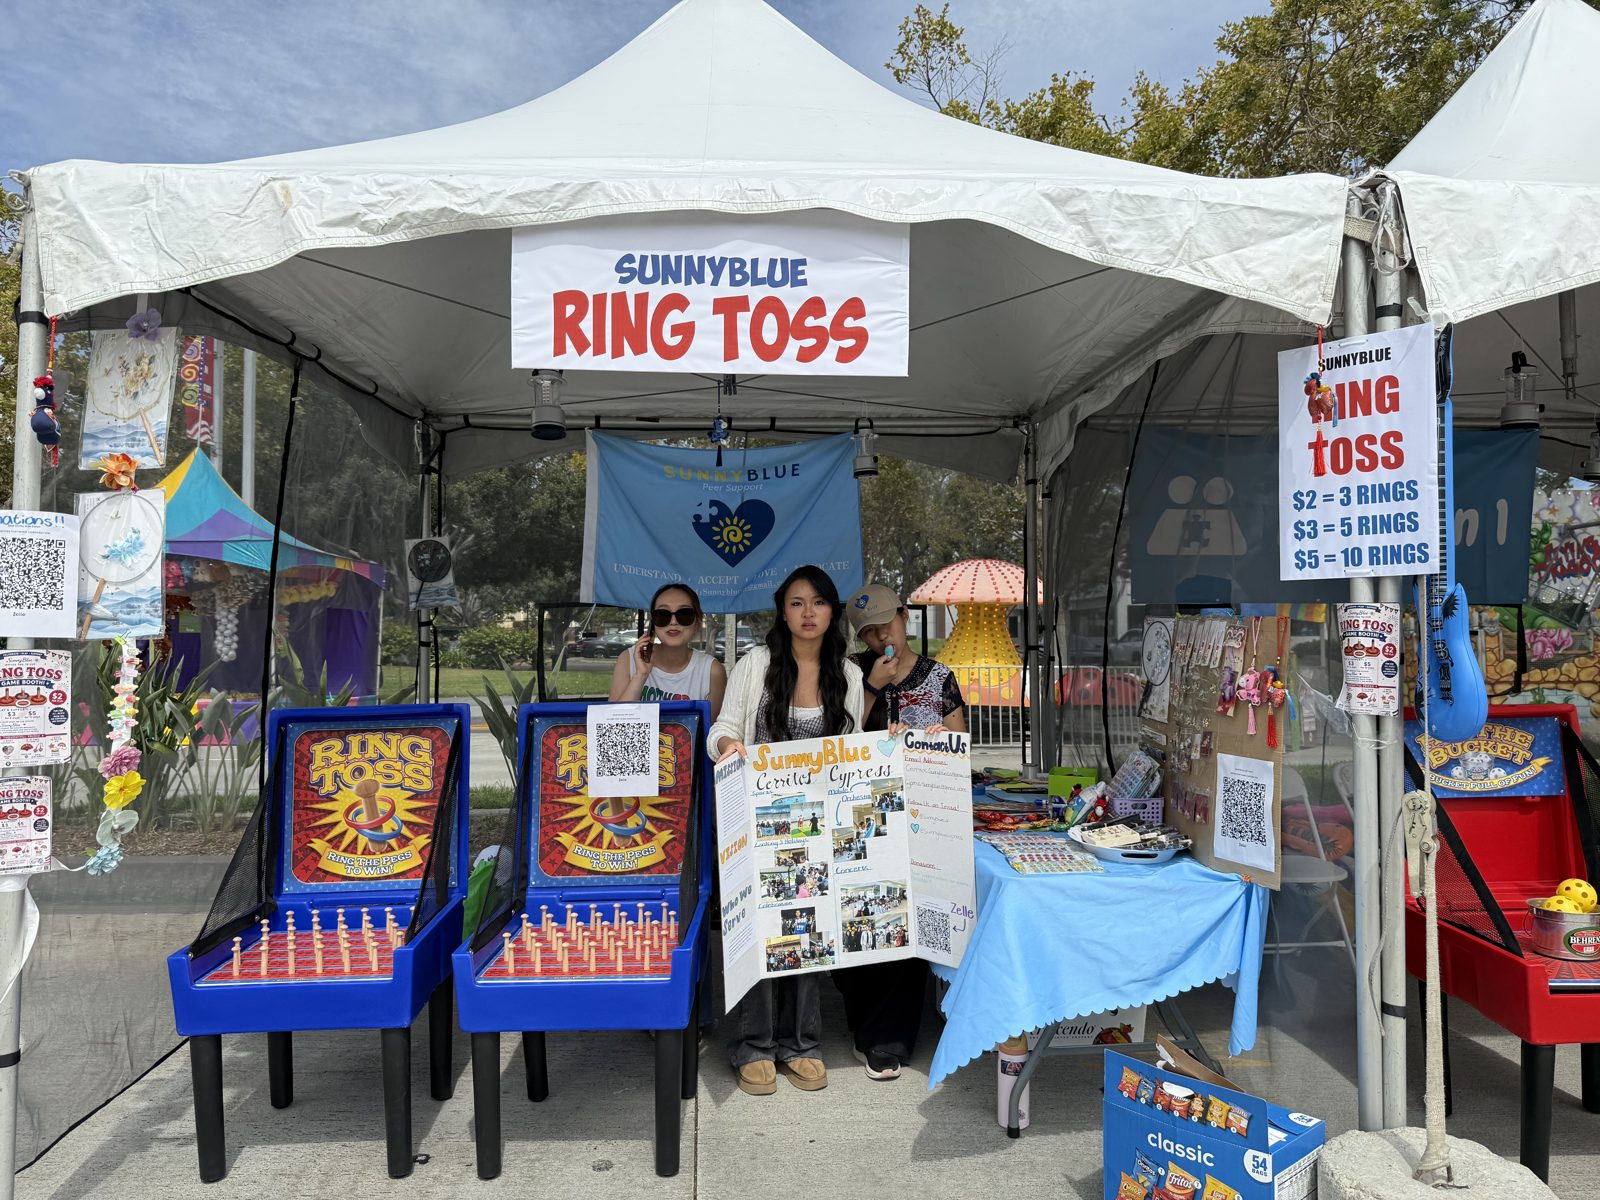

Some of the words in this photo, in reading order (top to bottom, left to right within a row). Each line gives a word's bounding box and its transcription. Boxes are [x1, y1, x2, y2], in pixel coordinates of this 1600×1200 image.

[615, 253, 808, 288] SUNNYBLUE
[553, 289, 696, 361] RING
[712, 294, 869, 364] TOSS
[1318, 347, 1391, 372] SUNNYBLUE
[1312, 375, 1400, 424] ING
[702, 483, 723, 491] Peer
[725, 483, 764, 493] Support
[1293, 490, 1317, 512] $2
[1340, 486, 1351, 507] 3
[1357, 480, 1419, 505] RINGS
[1294, 520, 1318, 541] $3
[1341, 517, 1352, 537] 5
[1358, 511, 1419, 536] RINGS
[1295, 549, 1319, 571] $5
[1341, 547, 1362, 567] 10
[1368, 543, 1430, 566] RINGS
[614, 563, 682, 583] UNDERSTAND
[698, 575, 739, 585] ACCEPT
[754, 567, 777, 579] OVE
[1363, 620, 1393, 633] TOSS
[0, 667, 23, 678] NG
[27, 667, 63, 680] TOSS
[52, 692, 63, 700] $2
[557, 733, 676, 764] RG
[905, 731, 949, 753] Contact
[1478, 723, 1534, 749] THE
[311, 733, 434, 769] RING
[753, 737, 871, 774] SunnyBlue
[1428, 739, 1533, 769] BUCKET
[311, 760, 434, 796] TOSS
[756, 772, 811, 790] Cerritos
[830, 764, 891, 789] Cypress
[1470, 781, 1497, 789] FULL
[1498, 778, 1511, 786] OF
[1513, 766, 1537, 782] FUN!
[16, 790, 44, 799] TOSS
[328, 851, 355, 865] RING
[356, 857, 380, 866] THE
[382, 851, 412, 864] PEGS
[573, 845, 600, 859] RING
[602, 852, 625, 861] THE
[627, 845, 656, 858] PEGS
[720, 833, 748, 865] VISION
[345, 864, 361, 875] TO
[363, 864, 394, 875] WIN!
[591, 859, 606, 869] TO
[609, 859, 639, 869] WIN!
[722, 897, 738, 918] Who
[740, 884, 752, 901] We
[951, 902, 974, 919] Zelle
[722, 908, 746, 936] Serve
[1147, 1132, 1214, 1167] classic
[1252, 1154, 1267, 1171] 54
[1252, 1169, 1268, 1177] BAGS
[1169, 1172, 1192, 1189] Fritos
